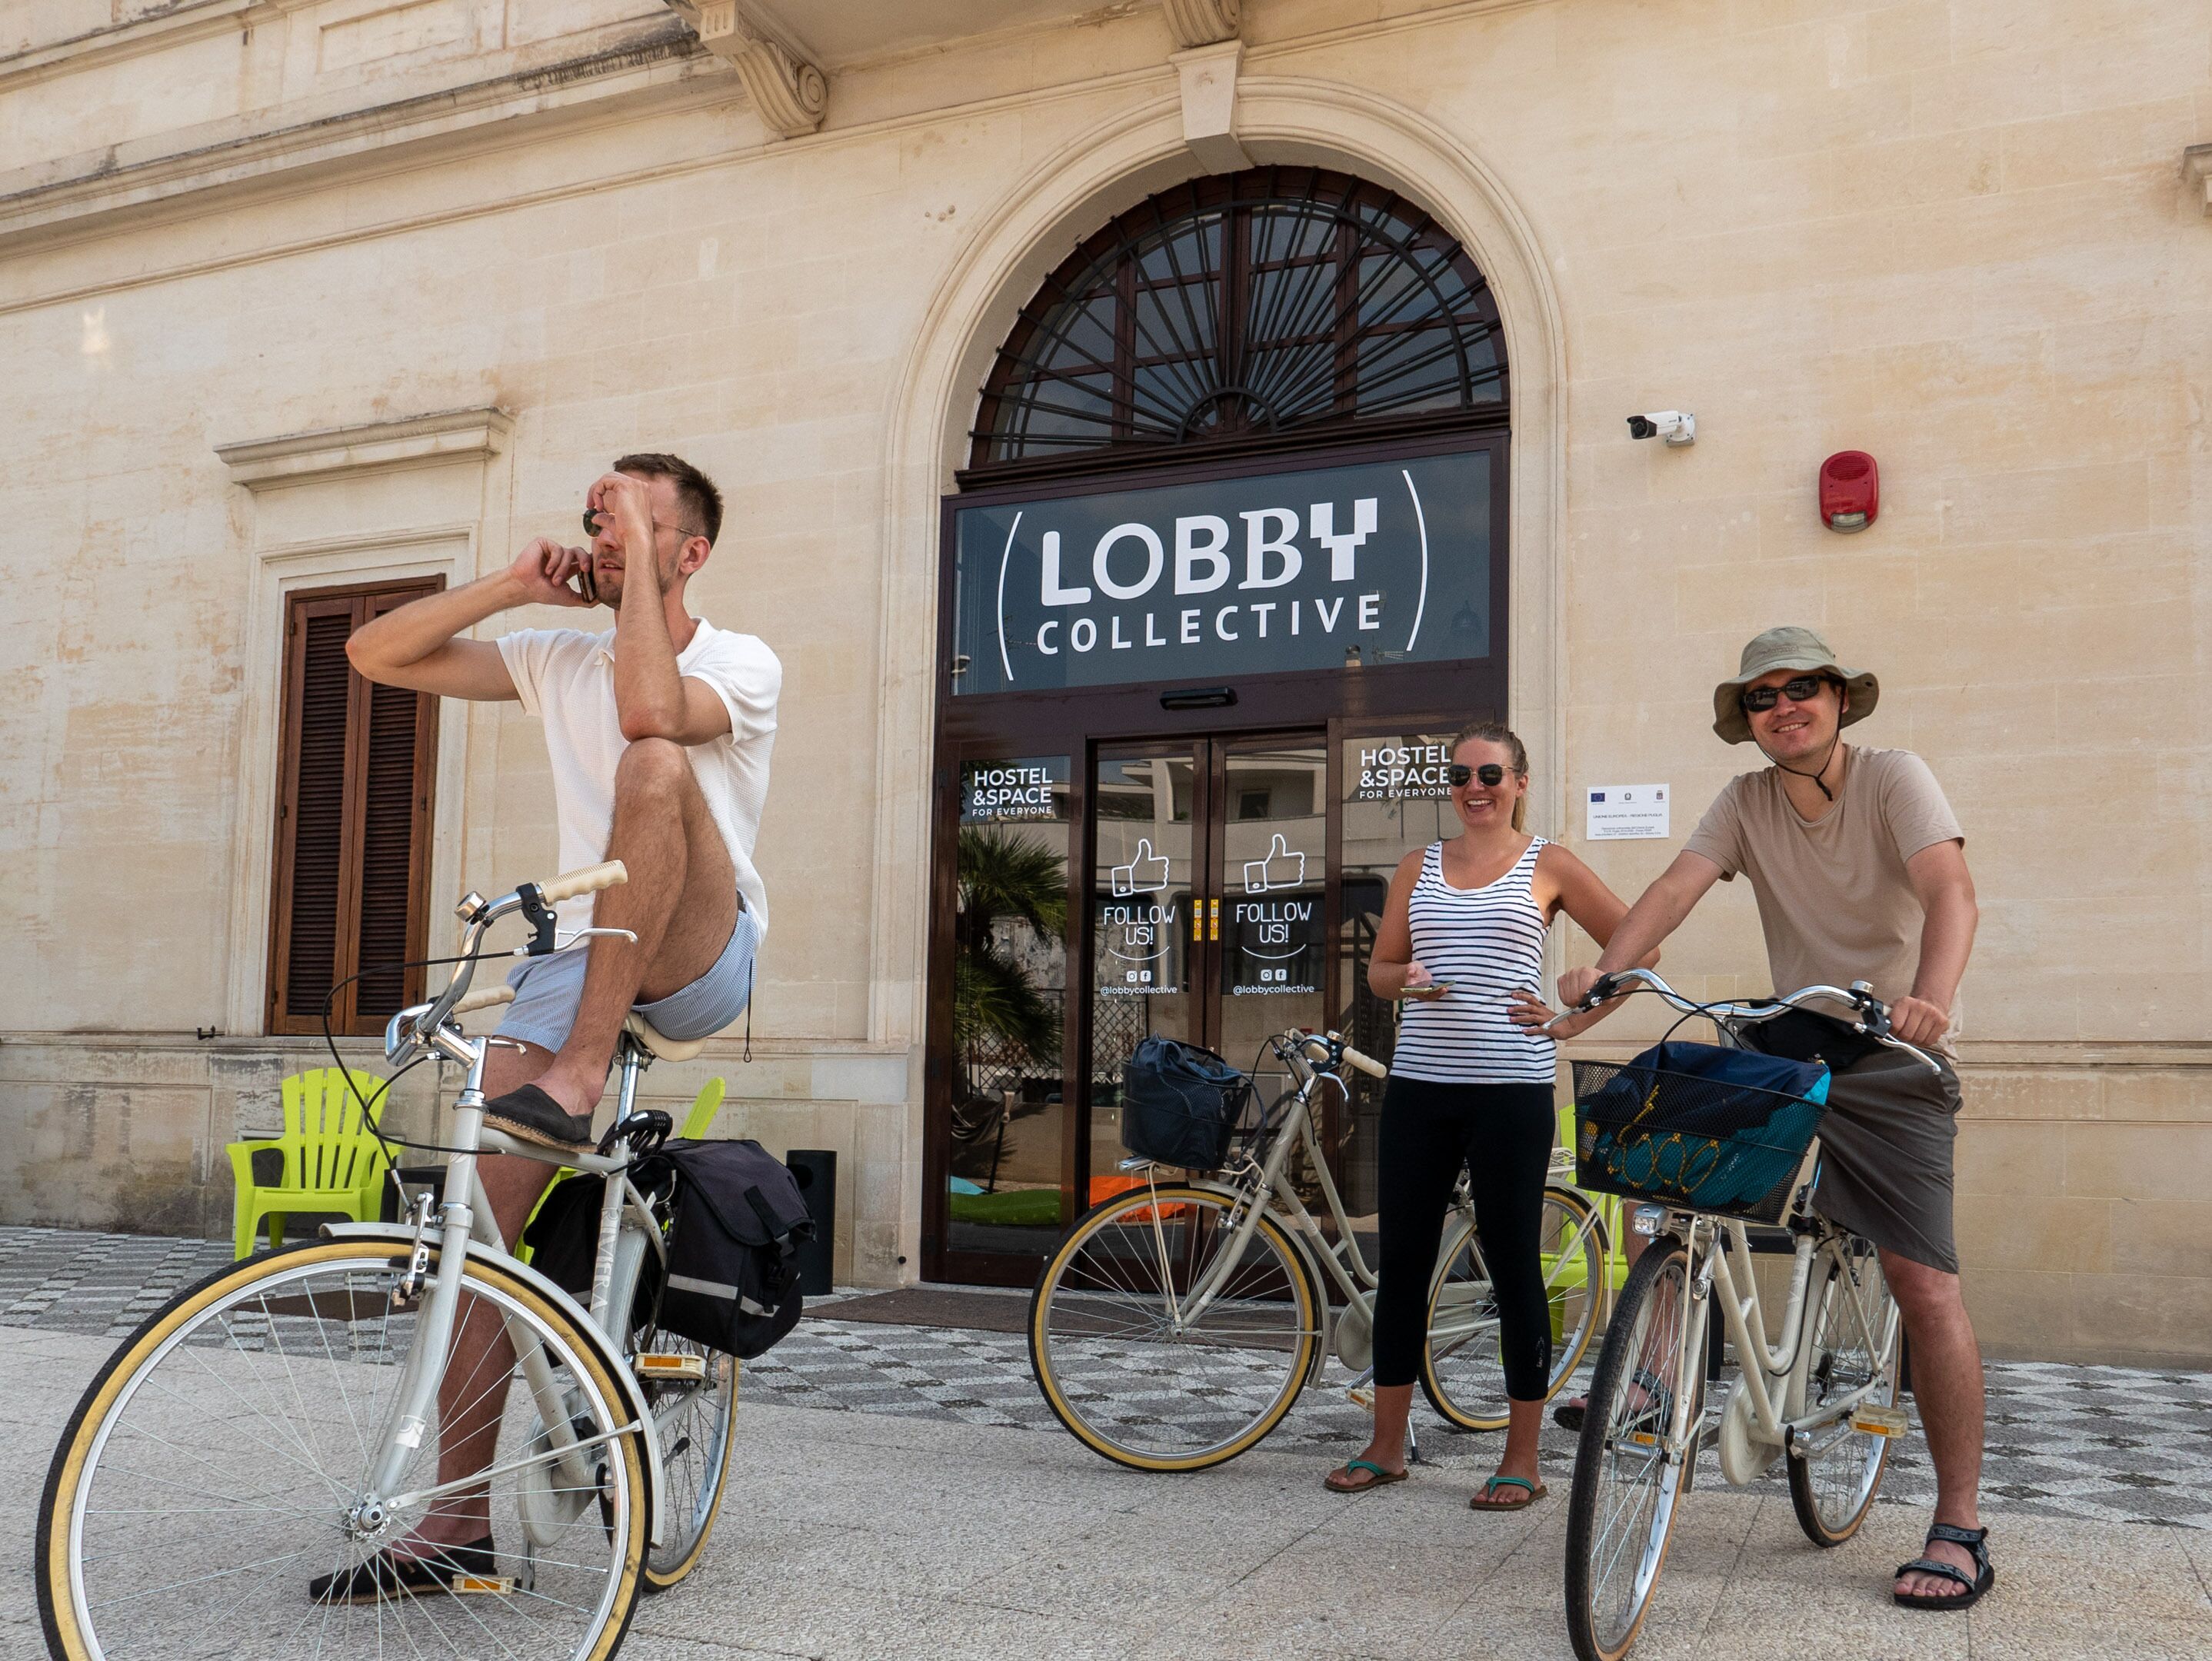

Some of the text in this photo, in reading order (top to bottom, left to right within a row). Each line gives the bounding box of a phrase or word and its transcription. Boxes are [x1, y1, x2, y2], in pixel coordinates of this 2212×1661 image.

[1041, 498, 1378, 607] LOBBY
[1037, 594, 1380, 654] COLLECTIVE
[1359, 745, 1451, 767] HOSTEL
[974, 767, 1053, 787] HOSTEL
[1360, 767, 1450, 787] &SPACE
[973, 787, 1052, 806] &SPACE
[1359, 787, 1452, 799] FOR EVERYONE
[997, 806, 1052, 816] EVERYONE
[1104, 906, 1176, 925] FOLLOW
[1236, 902, 1312, 923] FOLLOW
[1125, 927, 1154, 945] US!
[1259, 924, 1288, 944] US!
[1100, 985, 1178, 997] @lobbycollective
[1233, 984, 1314, 996] @lobbycollective
